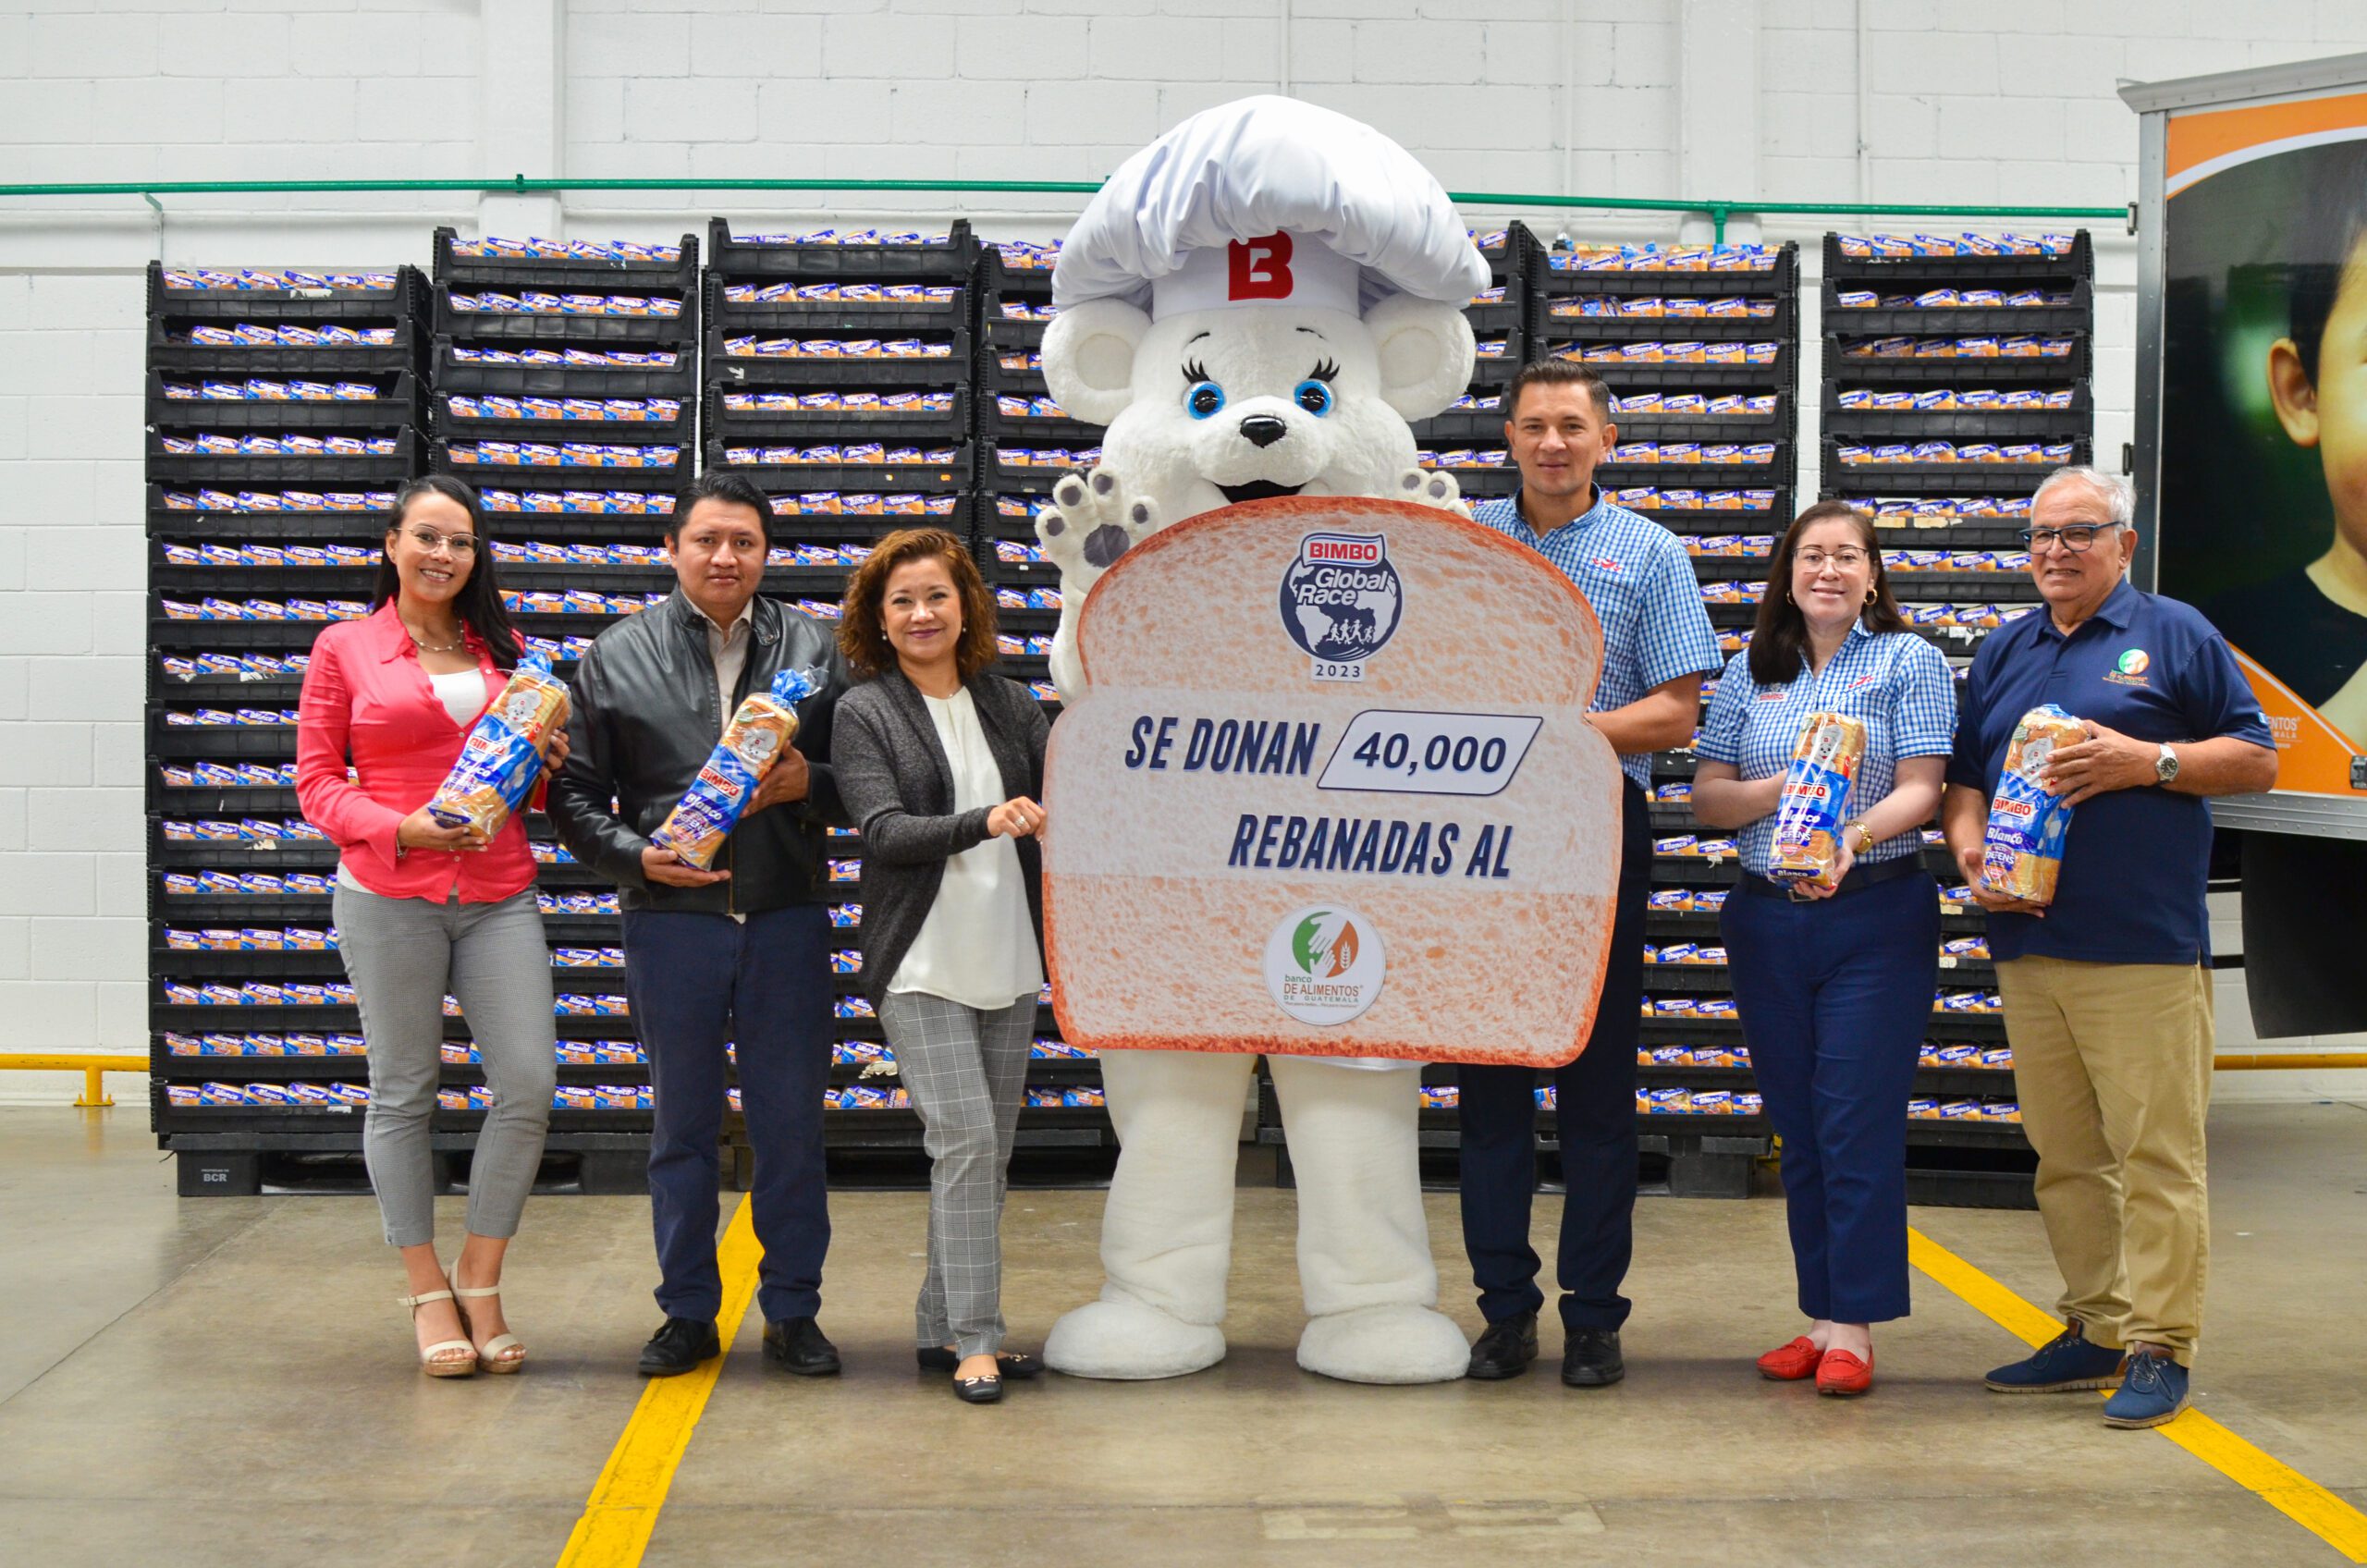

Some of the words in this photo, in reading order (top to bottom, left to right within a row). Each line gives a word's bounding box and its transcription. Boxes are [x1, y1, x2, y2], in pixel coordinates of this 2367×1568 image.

[1228, 229, 1294, 301] B
[1673, 254, 1699, 265] Blanco
[1919, 395, 1943, 408] Blanco
[1667, 446, 1692, 456] Blanco
[1881, 447, 1905, 457] Blanco
[1309, 543, 1378, 560] BIMBO
[1315, 568, 1388, 591] Global
[1297, 584, 1356, 606] Race
[1919, 609, 1944, 621] Blanco
[1962, 610, 1987, 621] Blanco
[1316, 664, 1361, 678] 2023
[2267, 716, 2298, 730] ENTOS
[1124, 715, 1179, 769] SE
[1183, 717, 1321, 775] DONAN
[1353, 731, 1507, 777] 40,000
[700, 768, 739, 797] BIMBO
[684, 792, 723, 821] Blanco
[1993, 798, 2031, 815] BIMBO
[1987, 827, 2023, 845] Blanco
[1228, 814, 1460, 875] REBANADAS
[1466, 824, 1514, 877] AL
[1664, 841, 1688, 851] Blanco
[1777, 869, 1809, 877] Blanco
[252, 877, 277, 887] Blanco
[568, 950, 592, 960] Blanco
[1284, 974, 1312, 984] banco
[1283, 983, 1298, 995] DE
[569, 996, 594, 1007] Blanco
[1304, 995, 1359, 1003] GUATEMALA
[1665, 1002, 1689, 1011] Blanco
[168, 1090, 193, 1098] Blanco
[215, 1089, 238, 1100] Blanco
[258, 1089, 282, 1100] Blanco
[1947, 1105, 1971, 1116] Blanco
[203, 1173, 227, 1182] BCR
